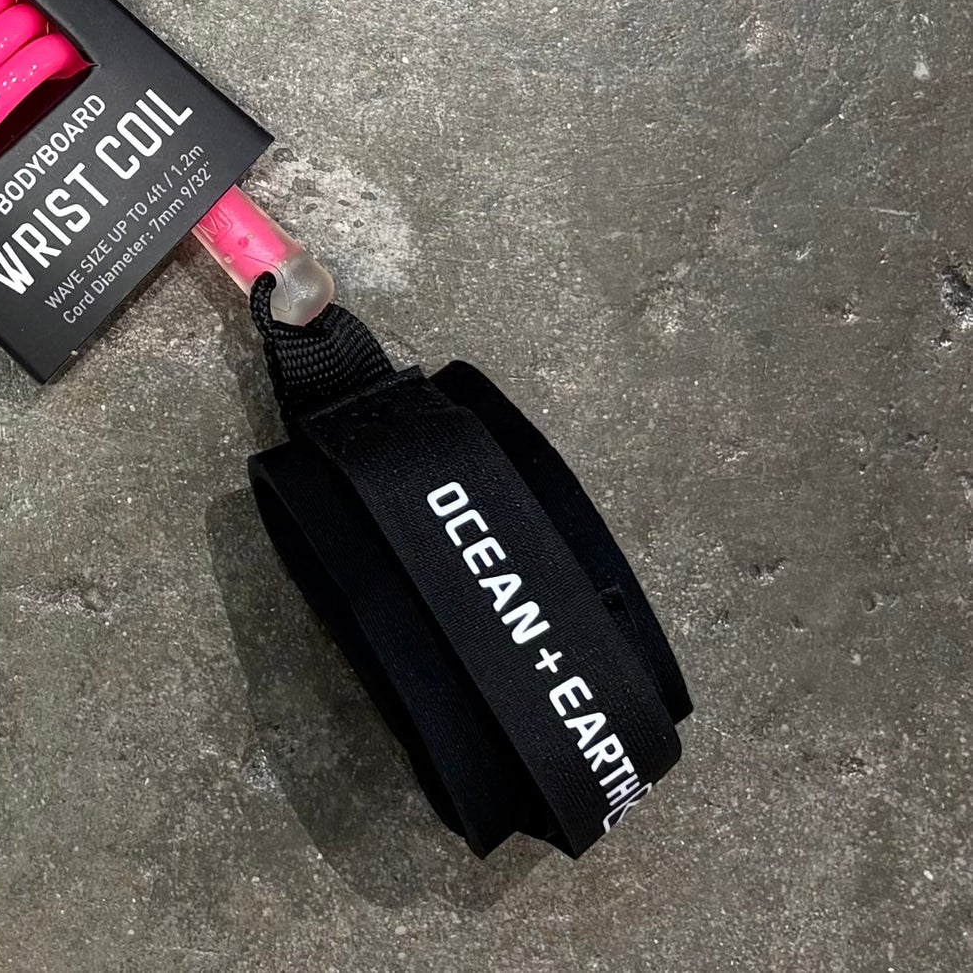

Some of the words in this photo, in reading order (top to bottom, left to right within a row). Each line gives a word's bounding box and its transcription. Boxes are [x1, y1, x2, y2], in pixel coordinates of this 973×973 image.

[95, 88, 193, 180] COIL
[44, 270, 84, 310] WAVE
[80, 239, 112, 274] SIZE
[107, 221, 128, 243] UP
[126, 202, 148, 225] TO
[147, 181, 167, 205] 4ft
[171, 144, 205, 176] 1.2m
[63, 290, 95, 324] Cord
[93, 231, 154, 295] Diameter:
[148, 199, 185, 233] 7mm
[427, 481, 550, 644] OCEAN
[549, 675, 641, 808] EARTH
